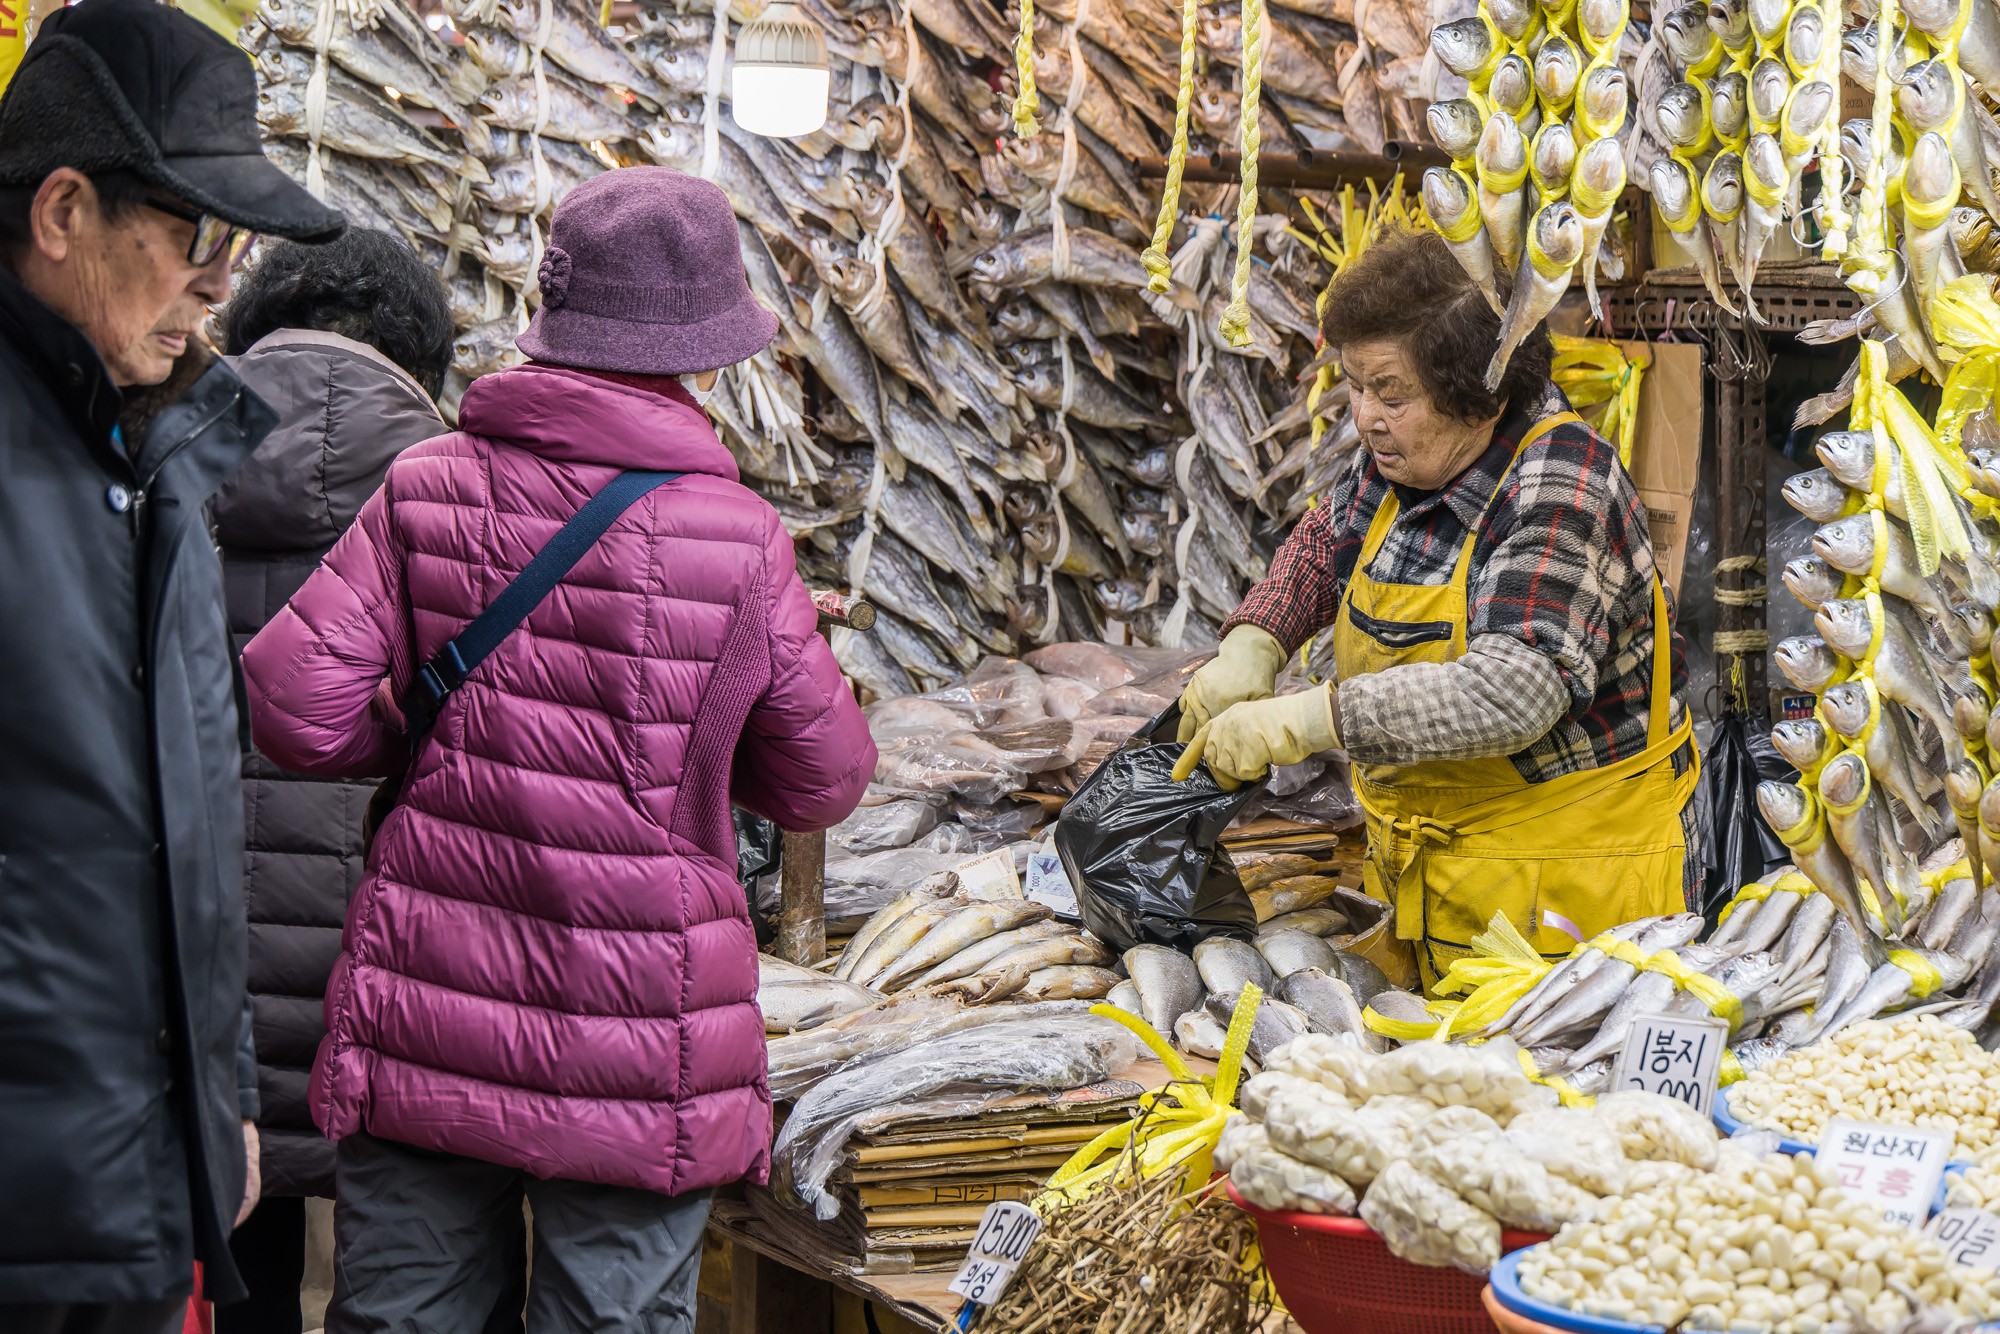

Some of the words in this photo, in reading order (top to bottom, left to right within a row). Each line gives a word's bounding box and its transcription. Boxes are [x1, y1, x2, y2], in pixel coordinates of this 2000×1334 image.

[959, 859, 981, 871] 5000
[1639, 1026, 1707, 1078] 1봉지
[1843, 1131, 1928, 1162] 원산지
